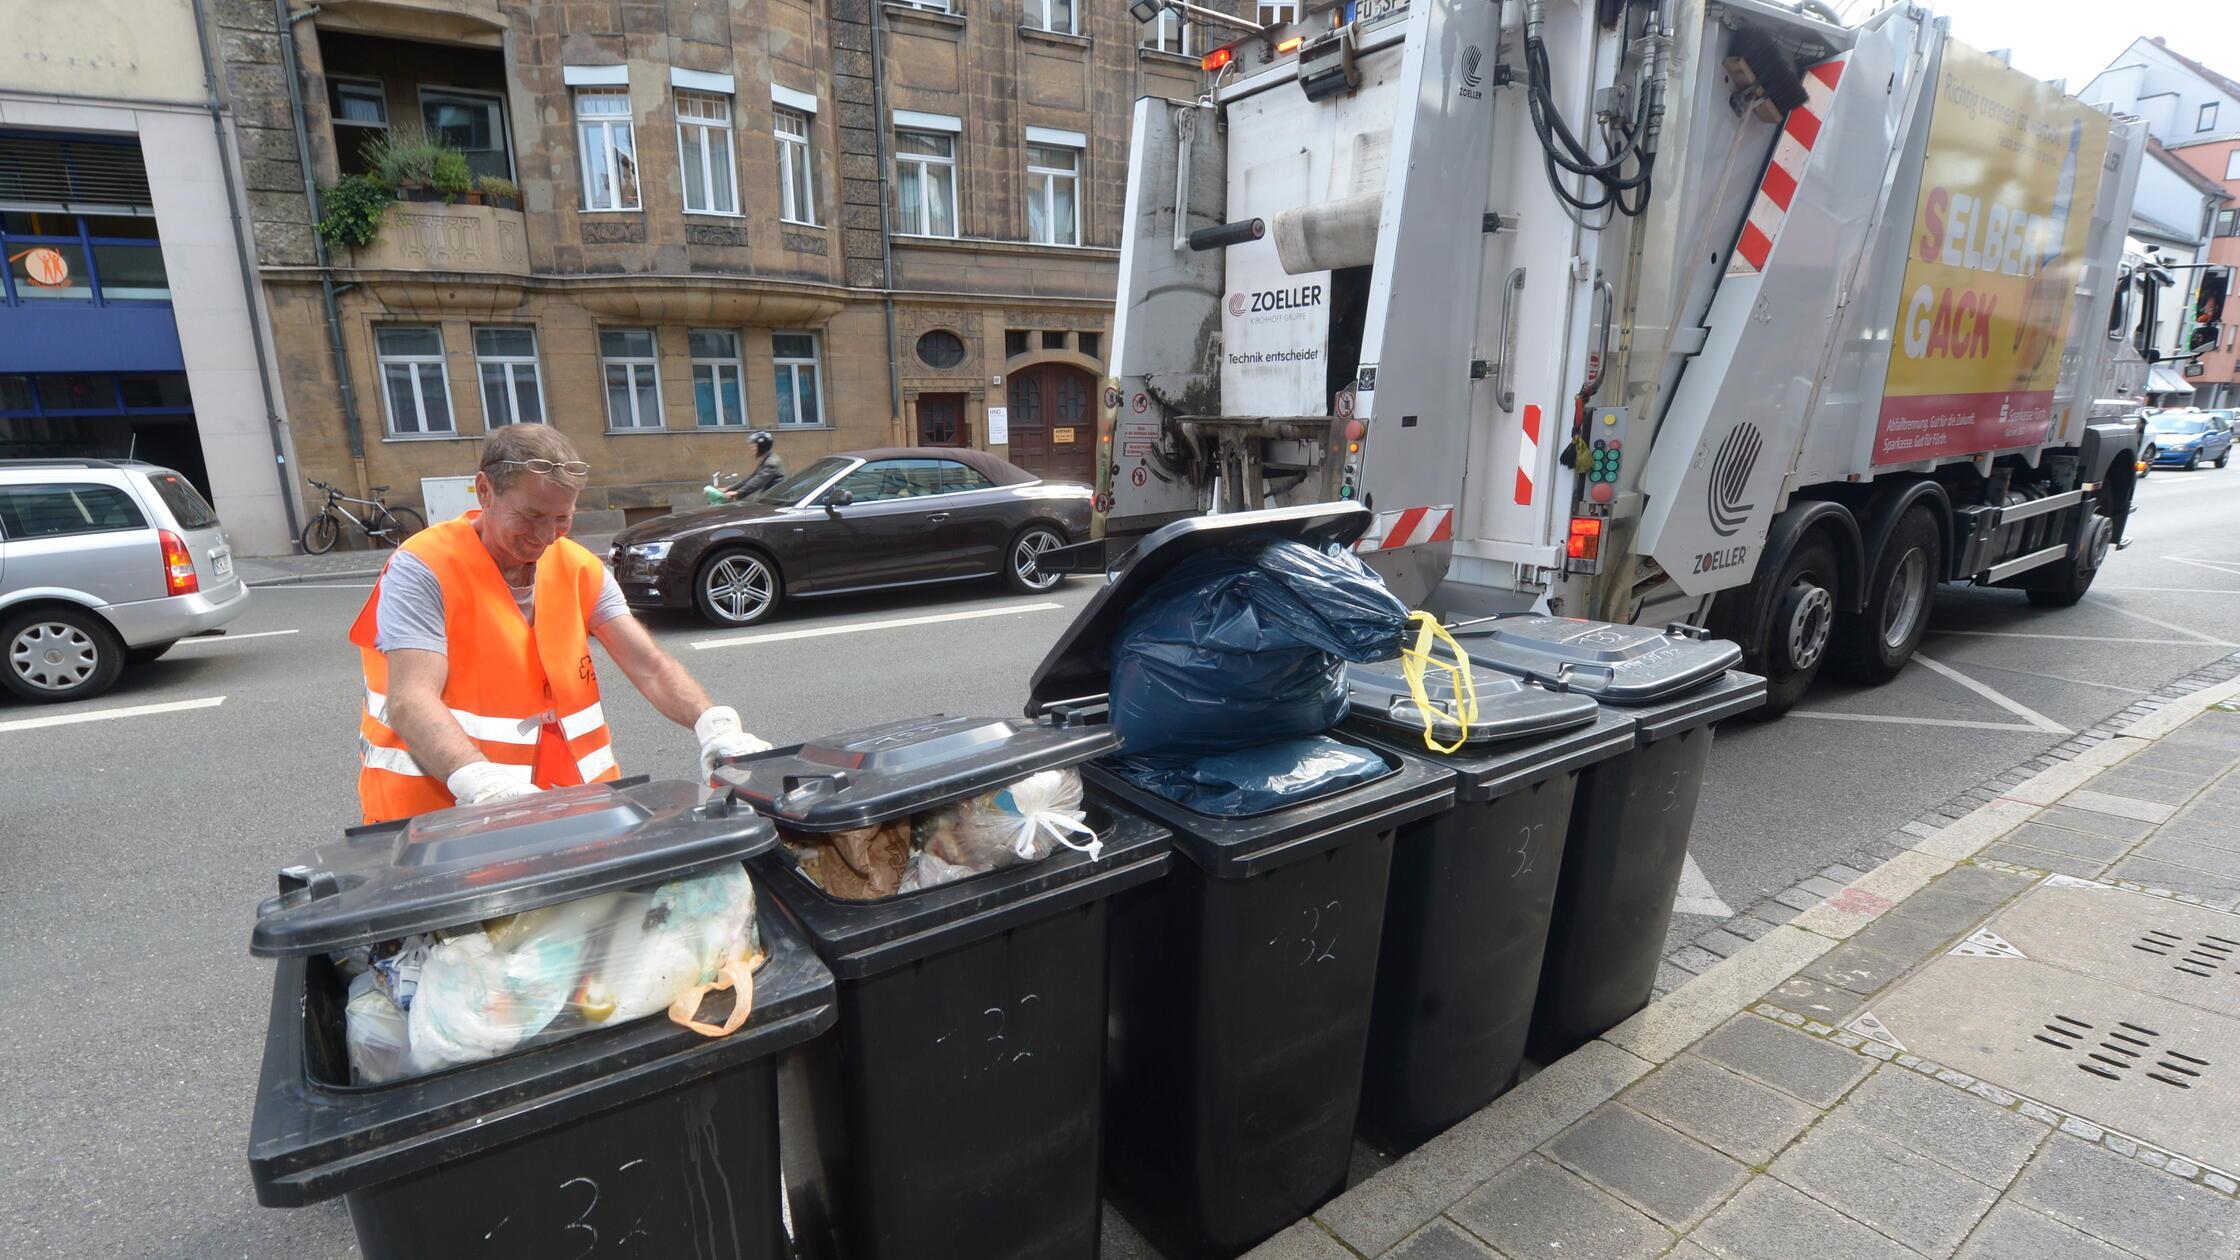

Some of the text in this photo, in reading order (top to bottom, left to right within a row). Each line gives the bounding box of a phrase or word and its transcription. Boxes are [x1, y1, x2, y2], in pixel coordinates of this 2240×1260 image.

[1919, 186, 2043, 279] SELBER
[1250, 285, 1322, 313] ZOELLER
[1250, 311, 1307, 325] KIRCHHOFF GRUPPE
[1903, 284, 1998, 360] GACK
[1228, 348, 1319, 365] Technik entscheidet
[1692, 545, 1747, 575] ZOELLER
